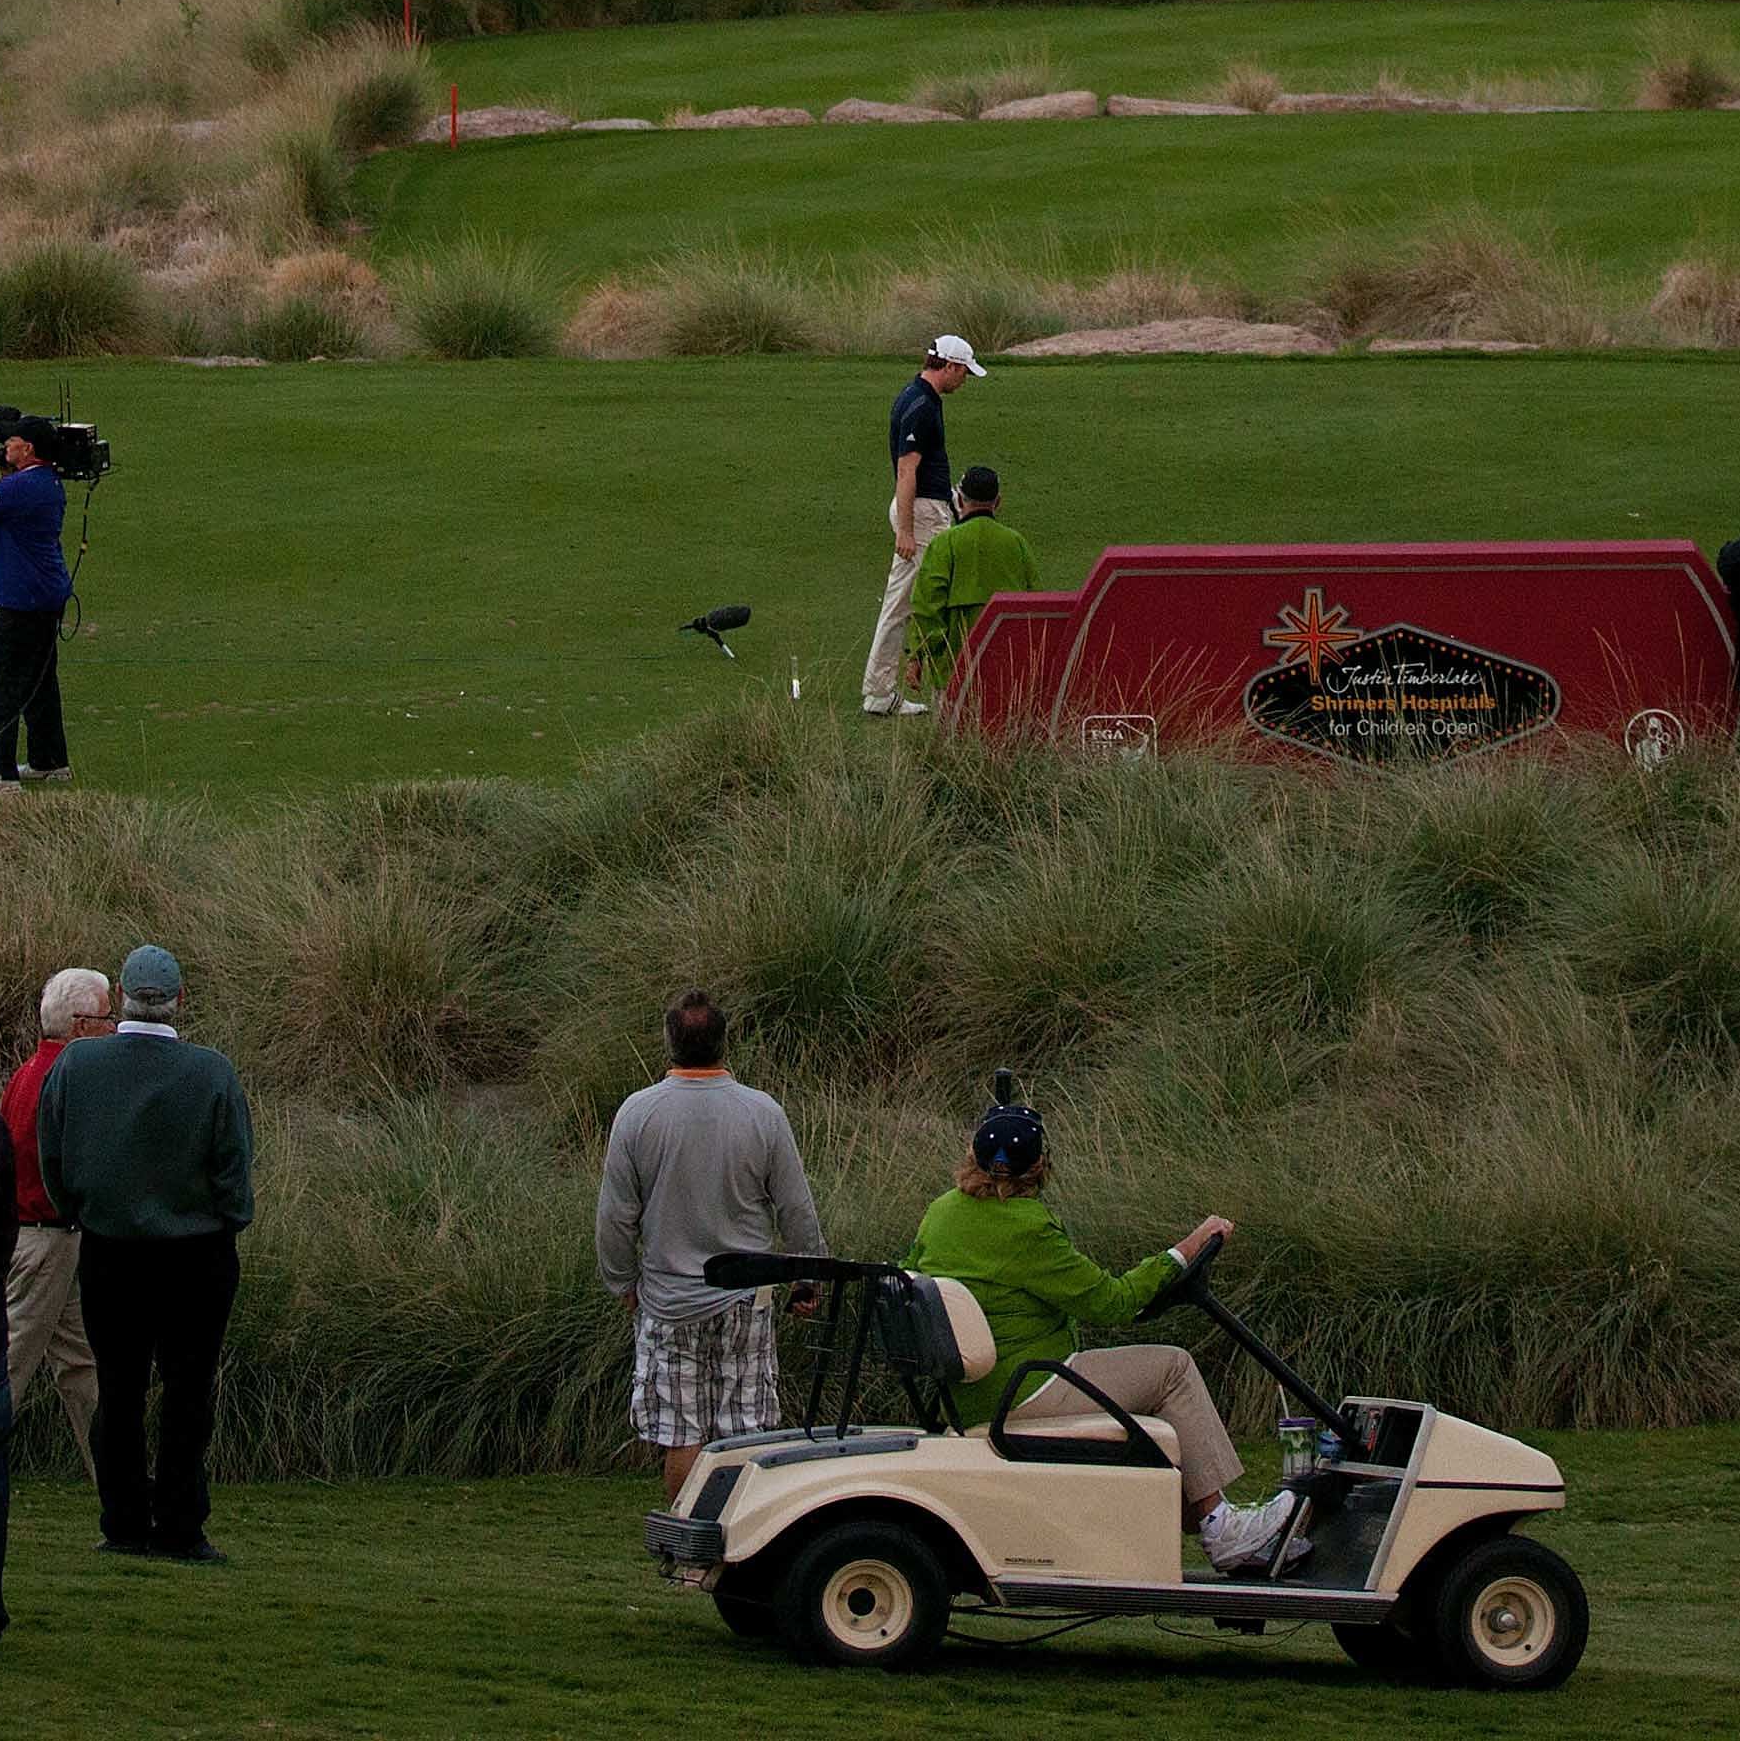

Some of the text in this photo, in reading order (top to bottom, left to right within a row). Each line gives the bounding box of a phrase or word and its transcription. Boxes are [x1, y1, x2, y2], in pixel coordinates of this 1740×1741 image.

[1326, 663, 1480, 692] Justin Timberlake
[1312, 694, 1495, 713] Shriners Hospitals
[1330, 719, 1477, 738] for Children Open
